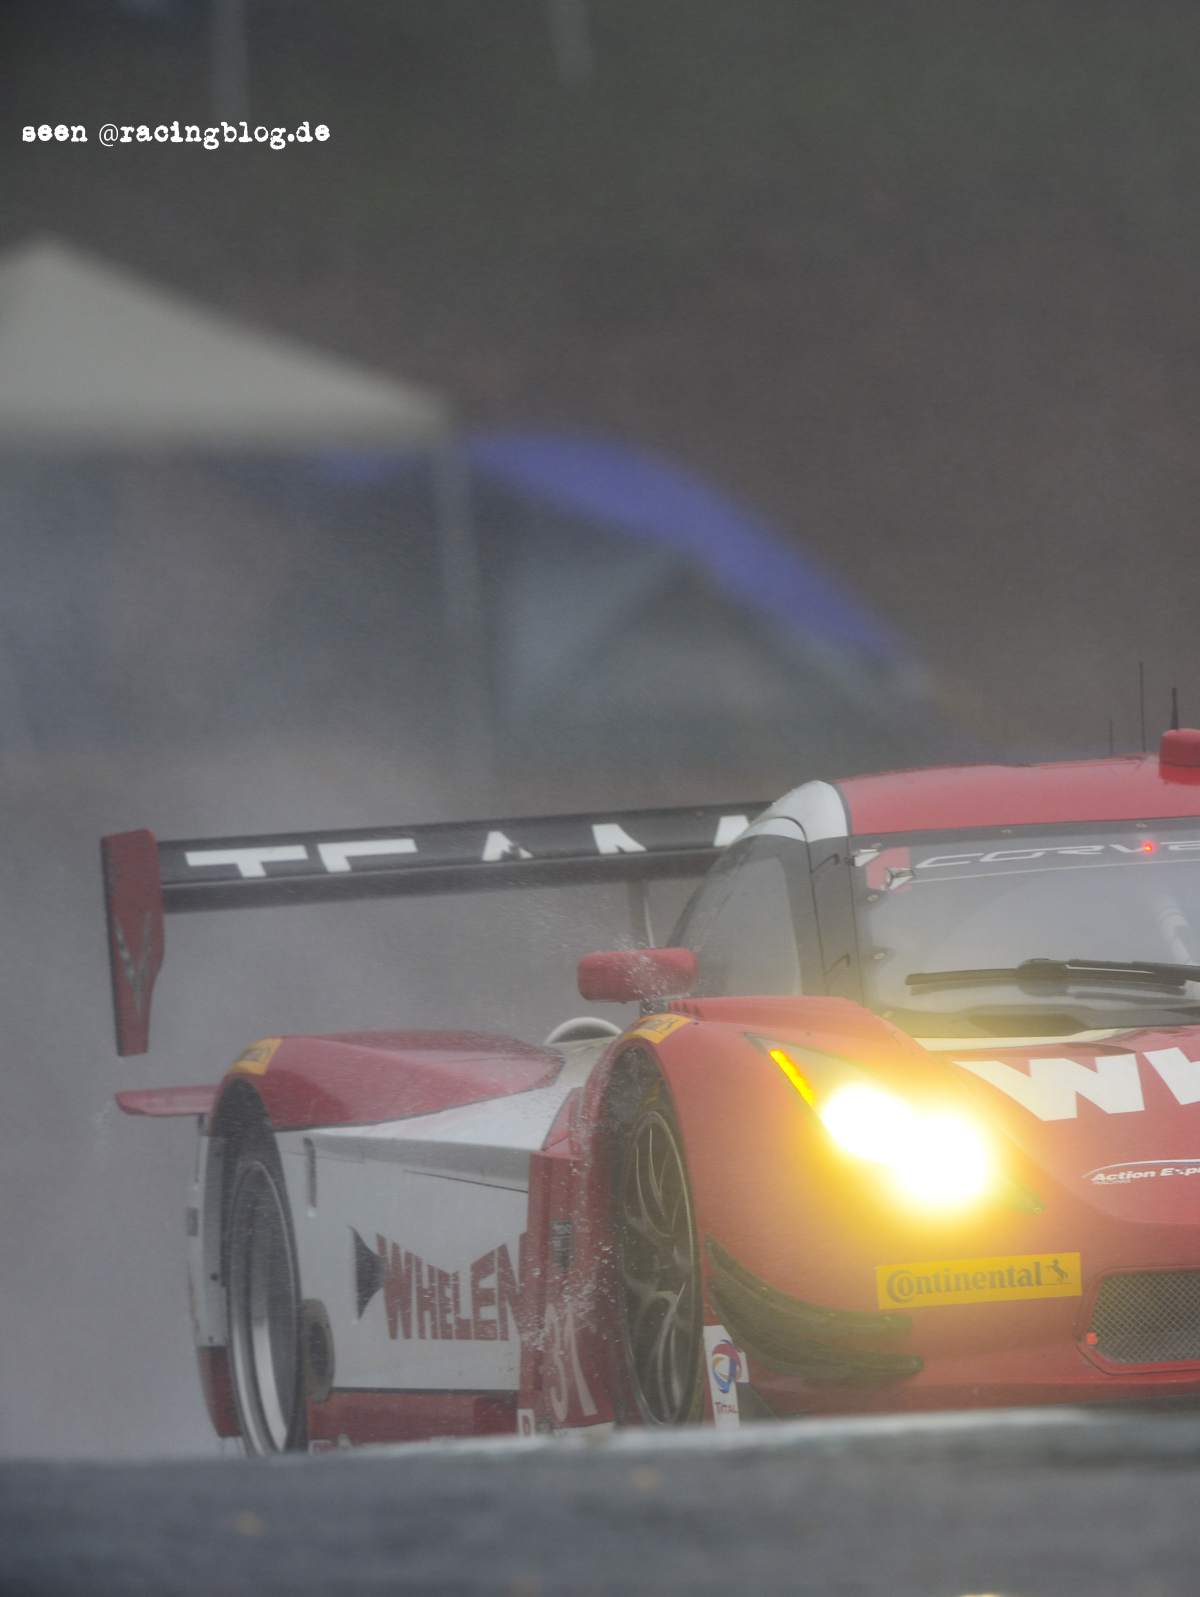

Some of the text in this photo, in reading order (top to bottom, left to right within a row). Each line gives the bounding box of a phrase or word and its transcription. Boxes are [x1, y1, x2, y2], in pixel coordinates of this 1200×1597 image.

[1090, 1170, 1156, 1182] Action
[376, 1232, 546, 1341] WHELEN
[885, 1261, 1042, 1304] Continental
